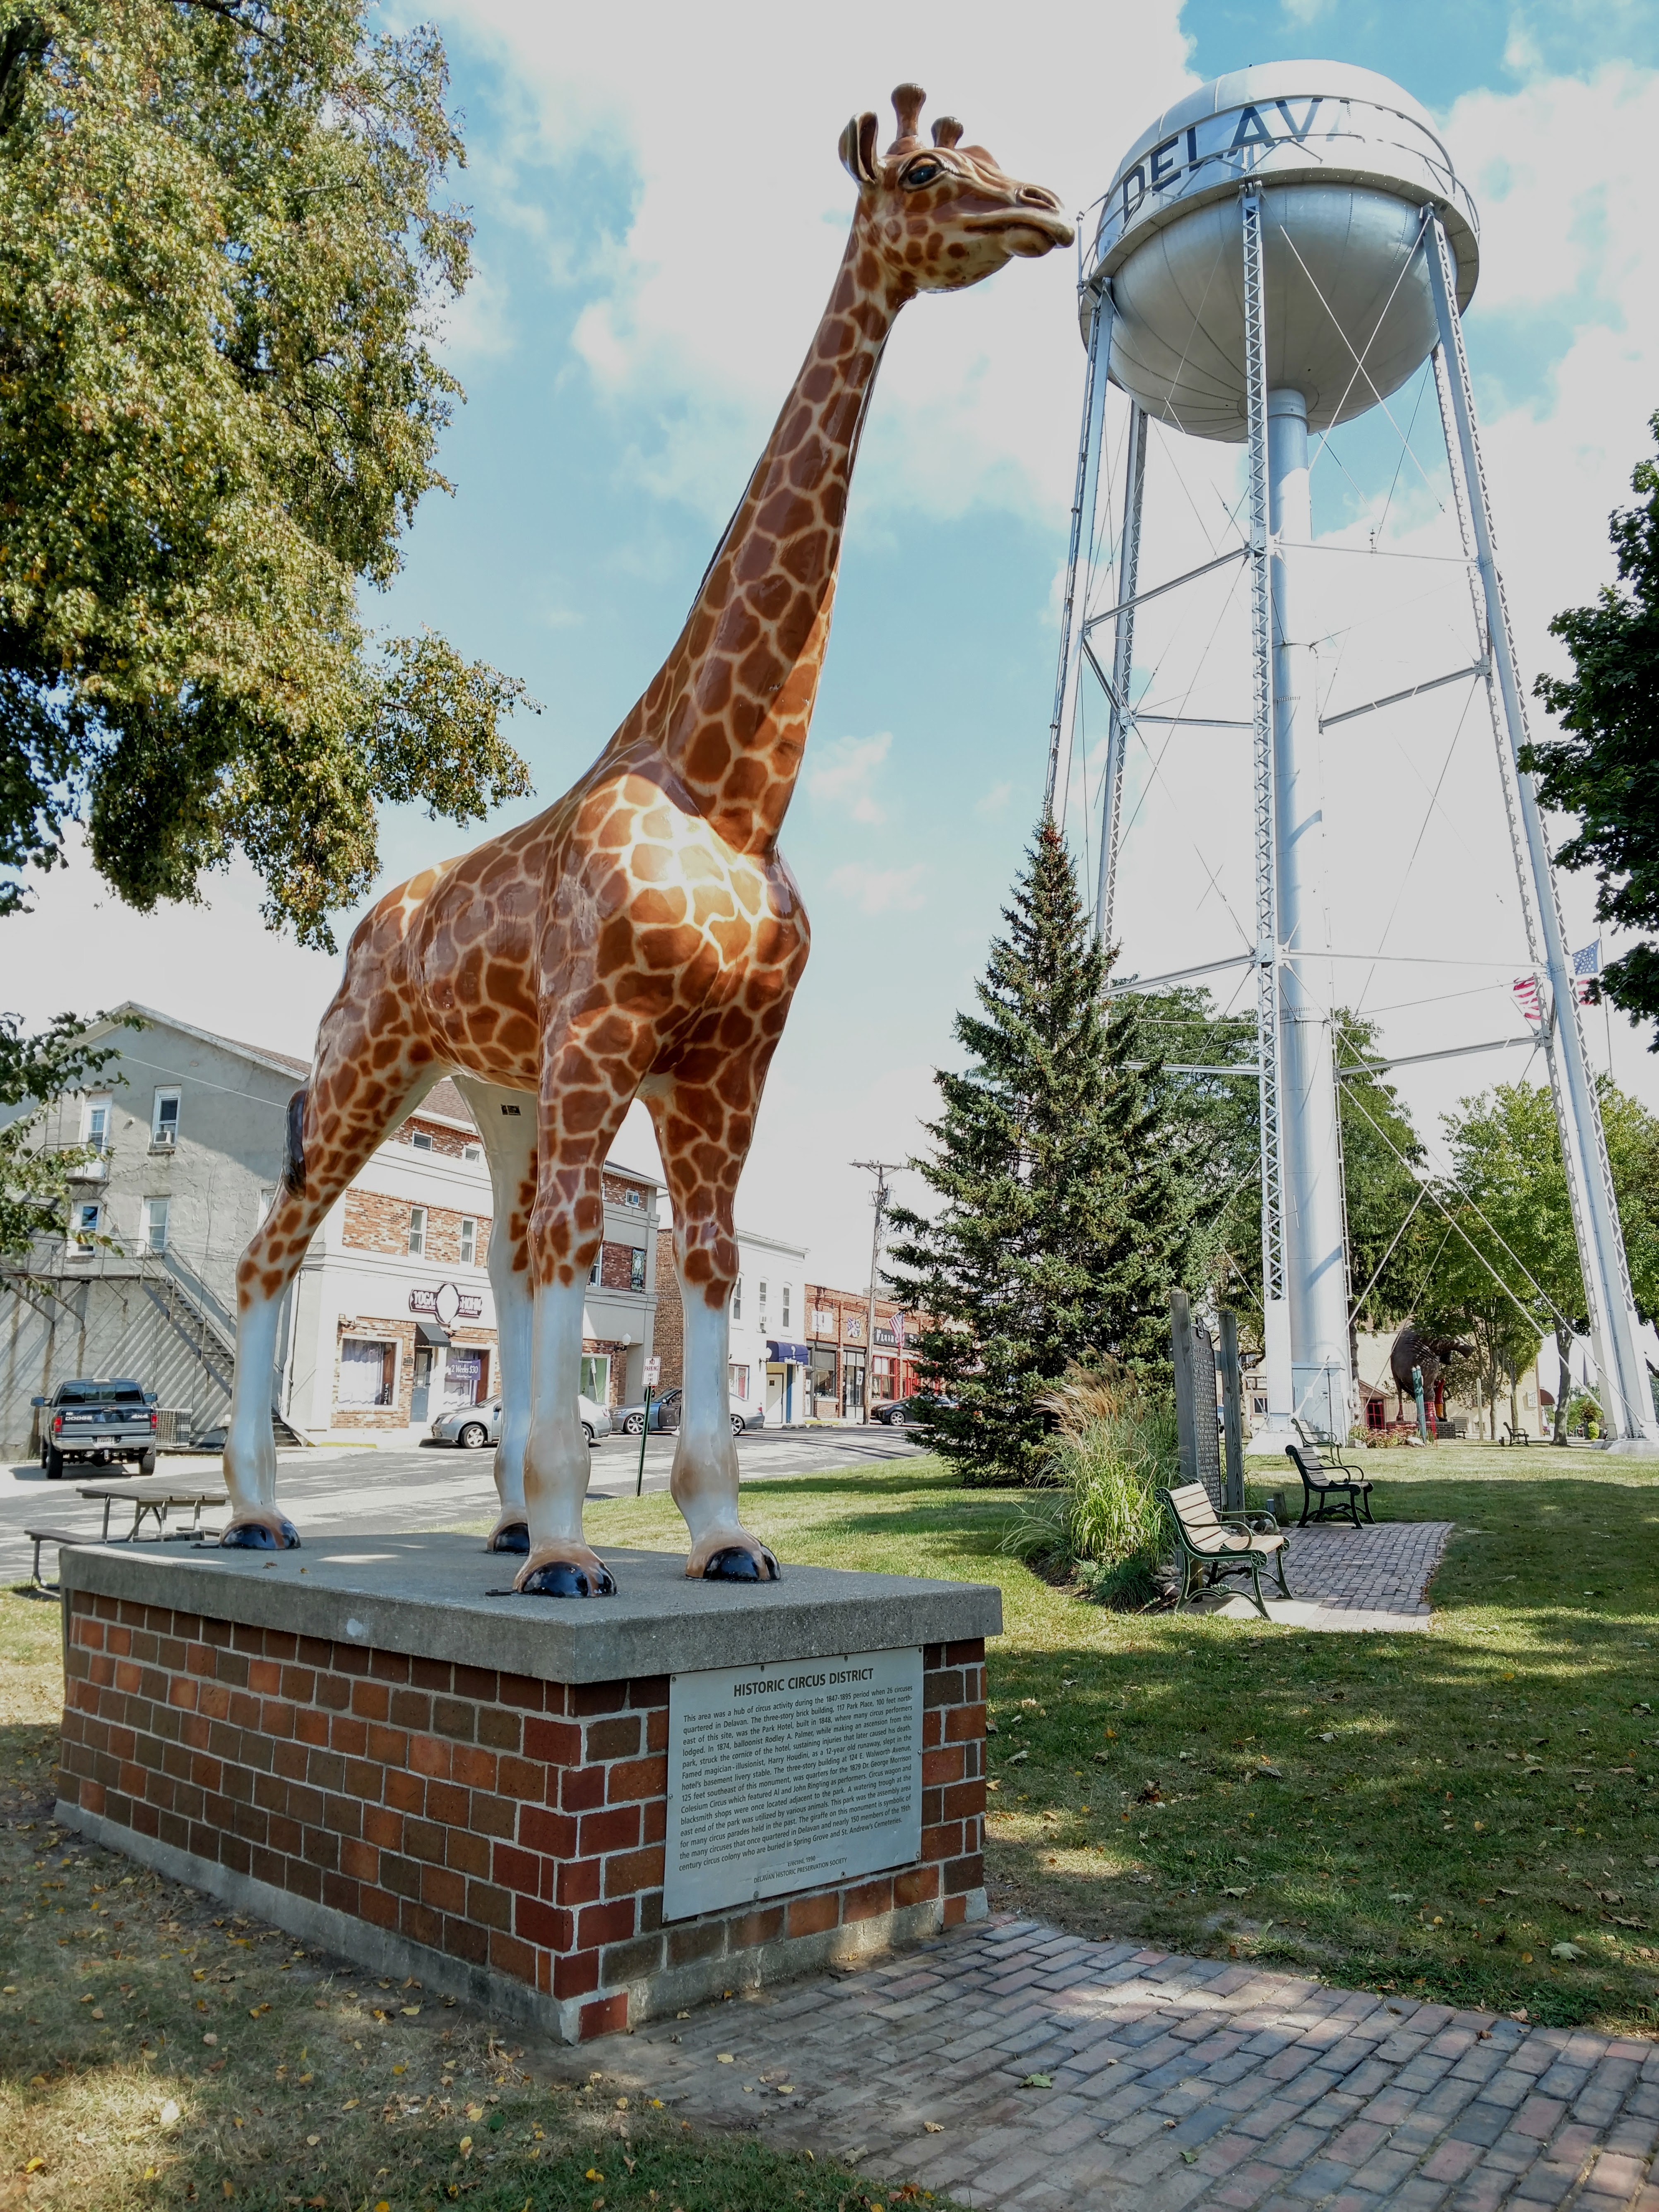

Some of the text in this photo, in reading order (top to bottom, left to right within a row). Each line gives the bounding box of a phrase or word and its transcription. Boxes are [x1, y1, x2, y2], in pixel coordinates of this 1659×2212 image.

[414, 1291, 435, 1305] YOGA
[456, 1364, 469, 1373] Weeks
[469, 1365, 478, 1373] $30
[734, 1668, 873, 1697] HISTORIC CIRCUS DISTRICT
[683, 1722, 713, 1735] quartered
[724, 1719, 748, 1728] Delavan.
[763, 1712, 794, 1722] three-story
[796, 1709, 809, 1717] brick
[811, 1705, 834, 1715] building,
[733, 1707, 745, 1715] hub
[773, 1701, 793, 1709] activity
[795, 1698, 813, 1707] during
[826, 1693, 851, 1702] 1847-1895
[853, 1690, 869, 1700] period
[683, 1737, 696, 1745] east
[698, 1734, 704, 1743] of
[707, 1733, 718, 1741] this
[762, 1724, 774, 1733] Park
[777, 1722, 794, 1731] Hotel,
[796, 1719, 809, 1728] built
[885, 1705, 912, 1716] performers
[683, 1746, 705, 1757] lodged.
[716, 1742, 731, 1750] 1874,
[734, 1738, 763, 1748] balloonist
[765, 1734, 784, 1743] Rodley
[833, 1724, 853, 1732] making
[863, 1719, 887, 1728] ascension
[682, 1758, 697, 1770] park,
[700, 1755, 717, 1765] struck
[732, 1750, 753, 1759] cornice
[774, 1743, 791, 1753] hotel,
[793, 1740, 820, 1750] sustaining
[822, 1736, 842, 1746] injuries
[869, 1728, 886, 1737] caused
[682, 1793, 691, 1802] 125
[693, 1791, 705, 1800] feet
[707, 1786, 736, 1797] southeast
[738, 1783, 744, 1791] of
[746, 1782, 757, 1790] this
[759, 1777, 791, 1788] monument,
[805, 1770, 828, 1781] quarters
[849, 1763, 861, 1771] 1879
[890, 1755, 911, 1764] Morrison
[680, 1828, 692, 1837] east
[694, 1824, 706, 1833] end
[707, 1822, 714, 1831] of
[727, 1818, 740, 1829] park
[755, 1810, 776, 1821] utilized
[778, 1810, 785, 1818] by
[786, 1806, 806, 1815] various
[808, 1801, 829, 1810] animals.
[843, 1795, 854, 1806] park
[877, 1786, 899, 1797] assembly
[679, 1861, 702, 1871] century
[703, 1857, 720, 1866] circus
[721, 1852, 741, 1861] colony
[742, 1849, 755, 1857] who
[767, 1841, 785, 1851] buried
[793, 1837, 811, 1847] Spring
[830, 1829, 840, 1838] and
[849, 1823, 873, 1834] Andrew's
[874, 1817, 902, 1828] Cemeteries.
[691, 1848, 708, 1857] many
[709, 1843, 732, 1853] circuses
[733, 1839, 745, 1848] that
[762, 1829, 789, 1843] quartered
[798, 1825, 819, 1834] Delavan
[821, 1820, 831, 1829] and
[832, 1818, 849, 1827] nearly
[860, 1811, 883, 1821] members
[754, 1857, 847, 1883] DELAVAN HISTORIC PRESERVATION SOCIETY
